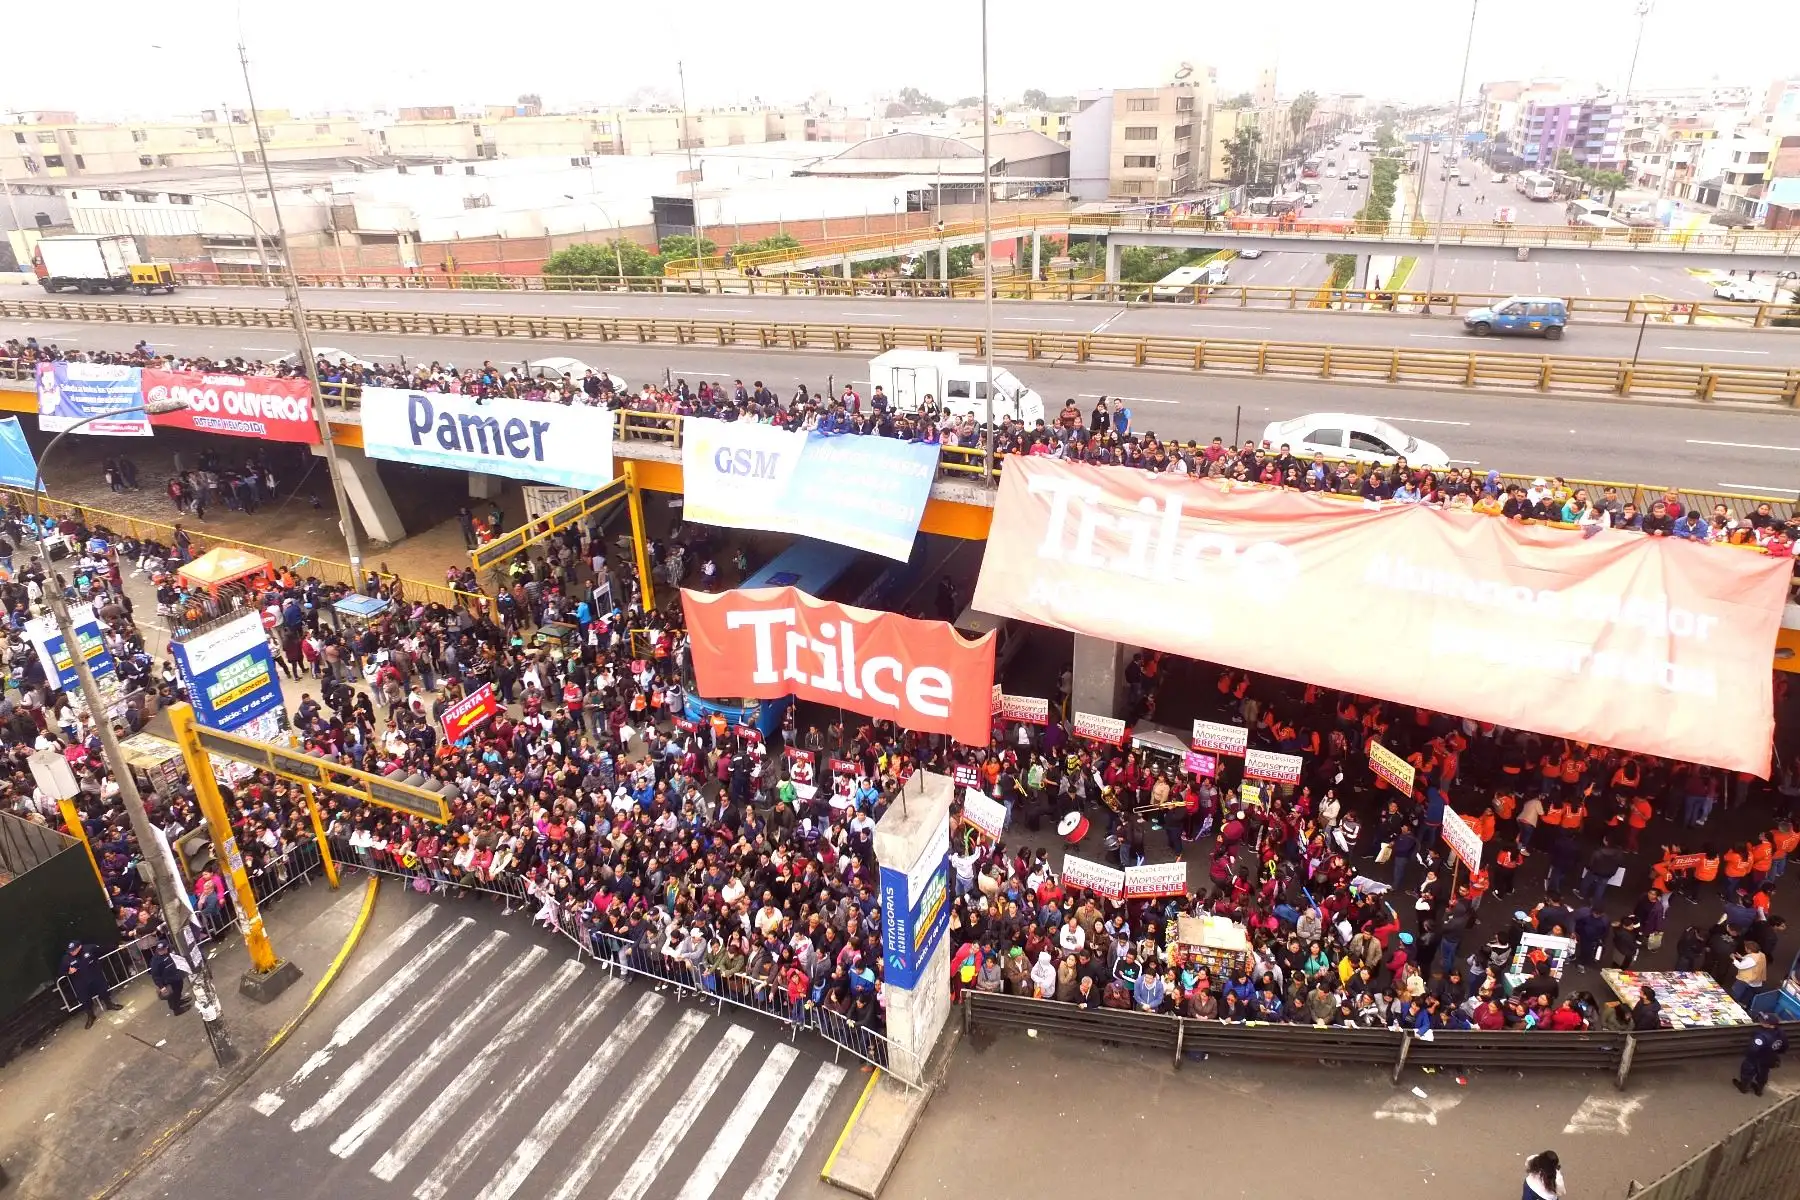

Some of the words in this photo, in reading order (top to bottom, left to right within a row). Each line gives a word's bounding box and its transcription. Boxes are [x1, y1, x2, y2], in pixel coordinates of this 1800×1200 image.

[223, 391, 308, 422] OLIVEROS
[408, 394, 550, 461] Pamer
[714, 446, 780, 480] GSM
[1027, 474, 1300, 605] Trilce
[221, 658, 251, 680] San
[726, 608, 951, 718] Trilce
[210, 664, 266, 697] Marcos
[218, 710, 242, 725] Inicio:
[242, 704, 250, 712] 17
[250, 700, 260, 708] de
[261, 692, 275, 703] Set.
[445, 694, 484, 725] PUERTA
[483, 689, 490, 698] 2
[1002, 710, 1044, 720] PRESENTE
[681, 720, 693, 729] pre
[744, 729, 757, 739] pre
[1075, 726, 1120, 741] PRESENTE
[1195, 738, 1243, 753] PRESENTE
[1196, 730, 1245, 744] Monserrat
[841, 762, 855, 770] pre
[1247, 758, 1298, 773] Monserrat
[1247, 767, 1296, 780] PRESENTE
[1369, 759, 1410, 793] PRESENTE
[1065, 875, 1118, 896] PRESENTE
[1128, 882, 1182, 893] PRESENTE
